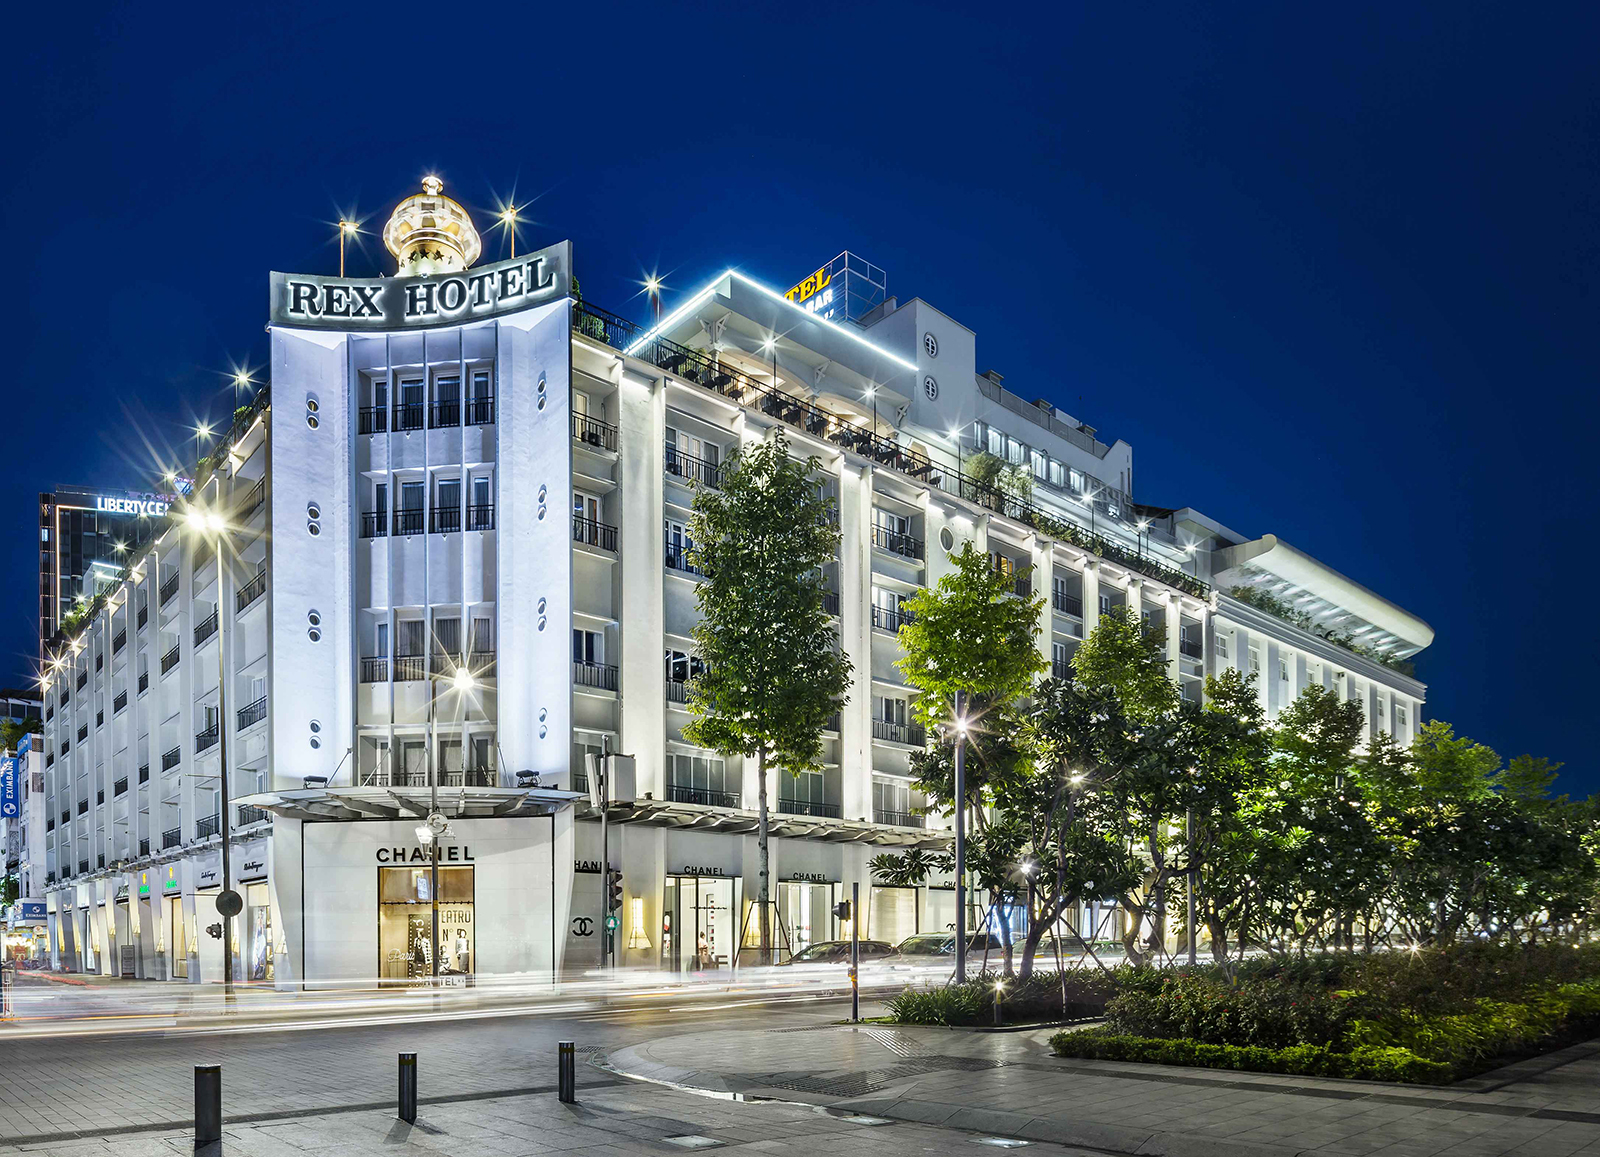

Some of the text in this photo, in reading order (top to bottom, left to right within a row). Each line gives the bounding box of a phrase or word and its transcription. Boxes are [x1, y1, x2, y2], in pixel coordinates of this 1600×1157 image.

[288, 258, 555, 318] REX HOTEL
[784, 267, 831, 303] TEL
[376, 845, 475, 863] CHANEL
[684, 865, 725, 876] CHANEL
[793, 872, 827, 881] CHANEL
[439, 909, 471, 924] EATRO
